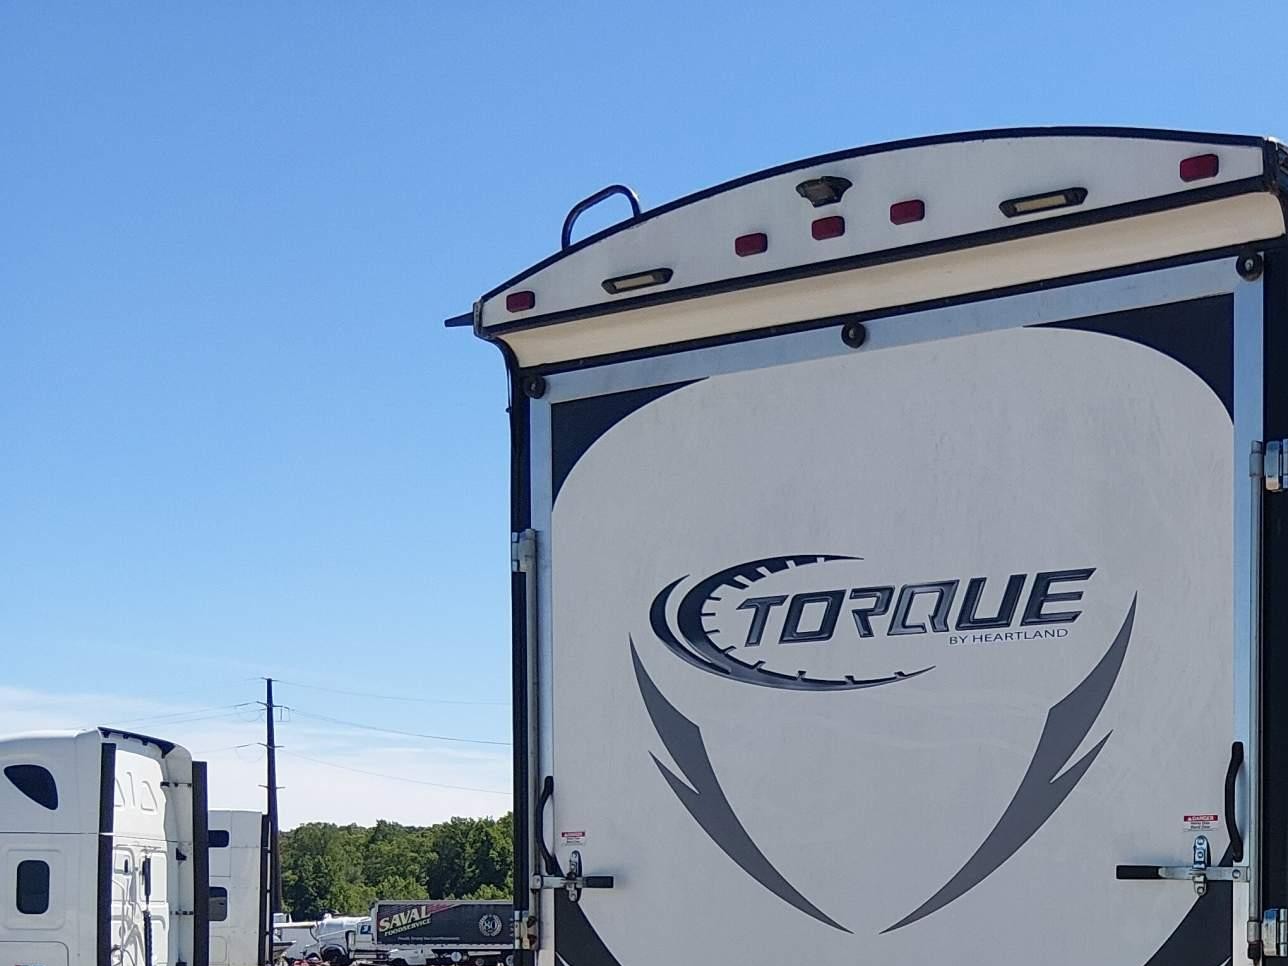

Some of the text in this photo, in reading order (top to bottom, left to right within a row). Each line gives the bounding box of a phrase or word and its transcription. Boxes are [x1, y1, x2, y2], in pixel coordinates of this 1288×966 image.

[736, 567, 1097, 648] TORQUE
[949, 628, 1068, 645] BY HEARTLAND
[378, 905, 432, 933] SAVAL
[384, 918, 432, 937] FOODSERVICE
